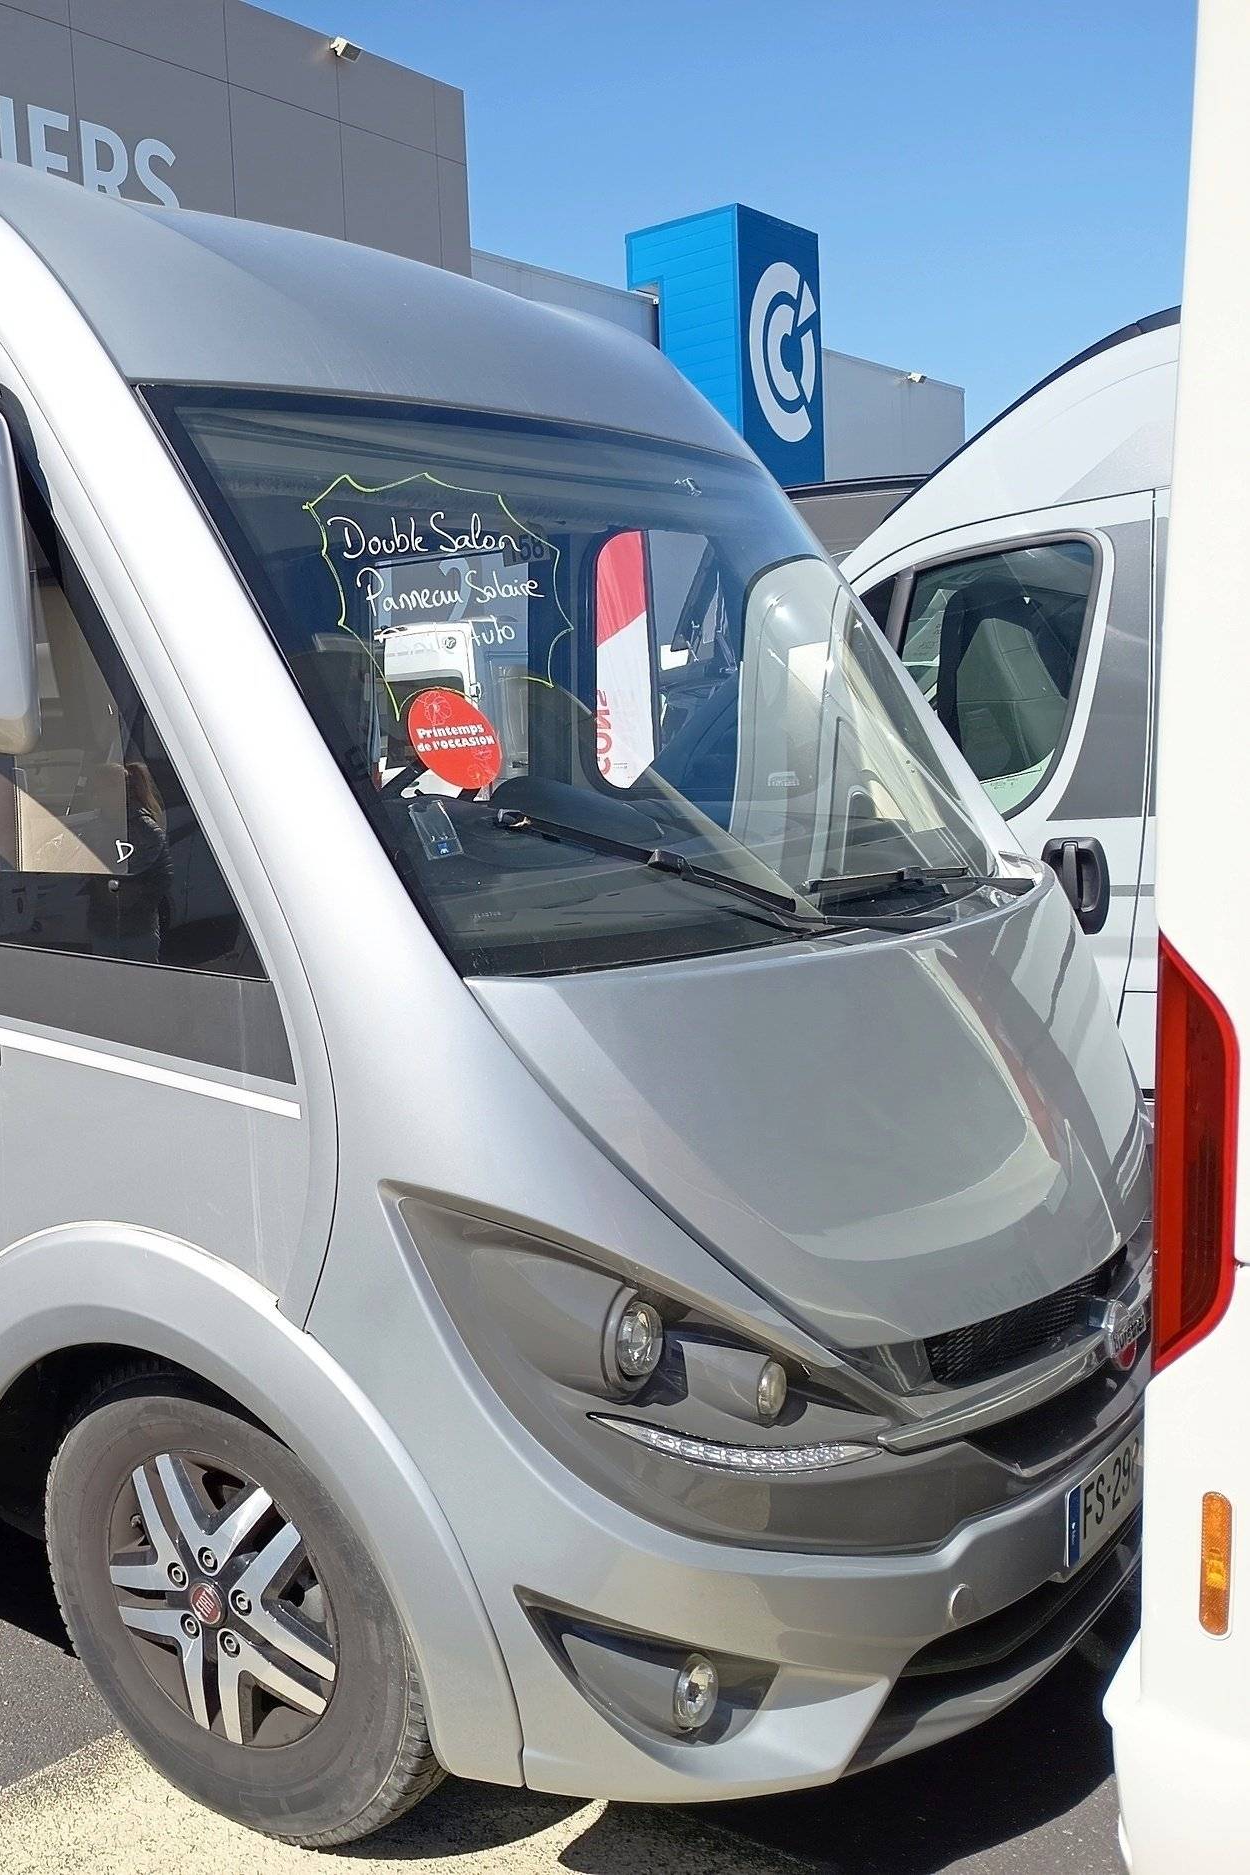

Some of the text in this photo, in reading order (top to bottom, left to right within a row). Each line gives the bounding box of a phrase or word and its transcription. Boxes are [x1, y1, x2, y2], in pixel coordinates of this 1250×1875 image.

[327, 512, 521, 559] Double Salon
[357, 567, 544, 616] Panneau Solaire
[415, 723, 485, 740] Printemps
[416, 735, 496, 753] de l'OCCASION
[195, 1590, 215, 1618] FIAT
